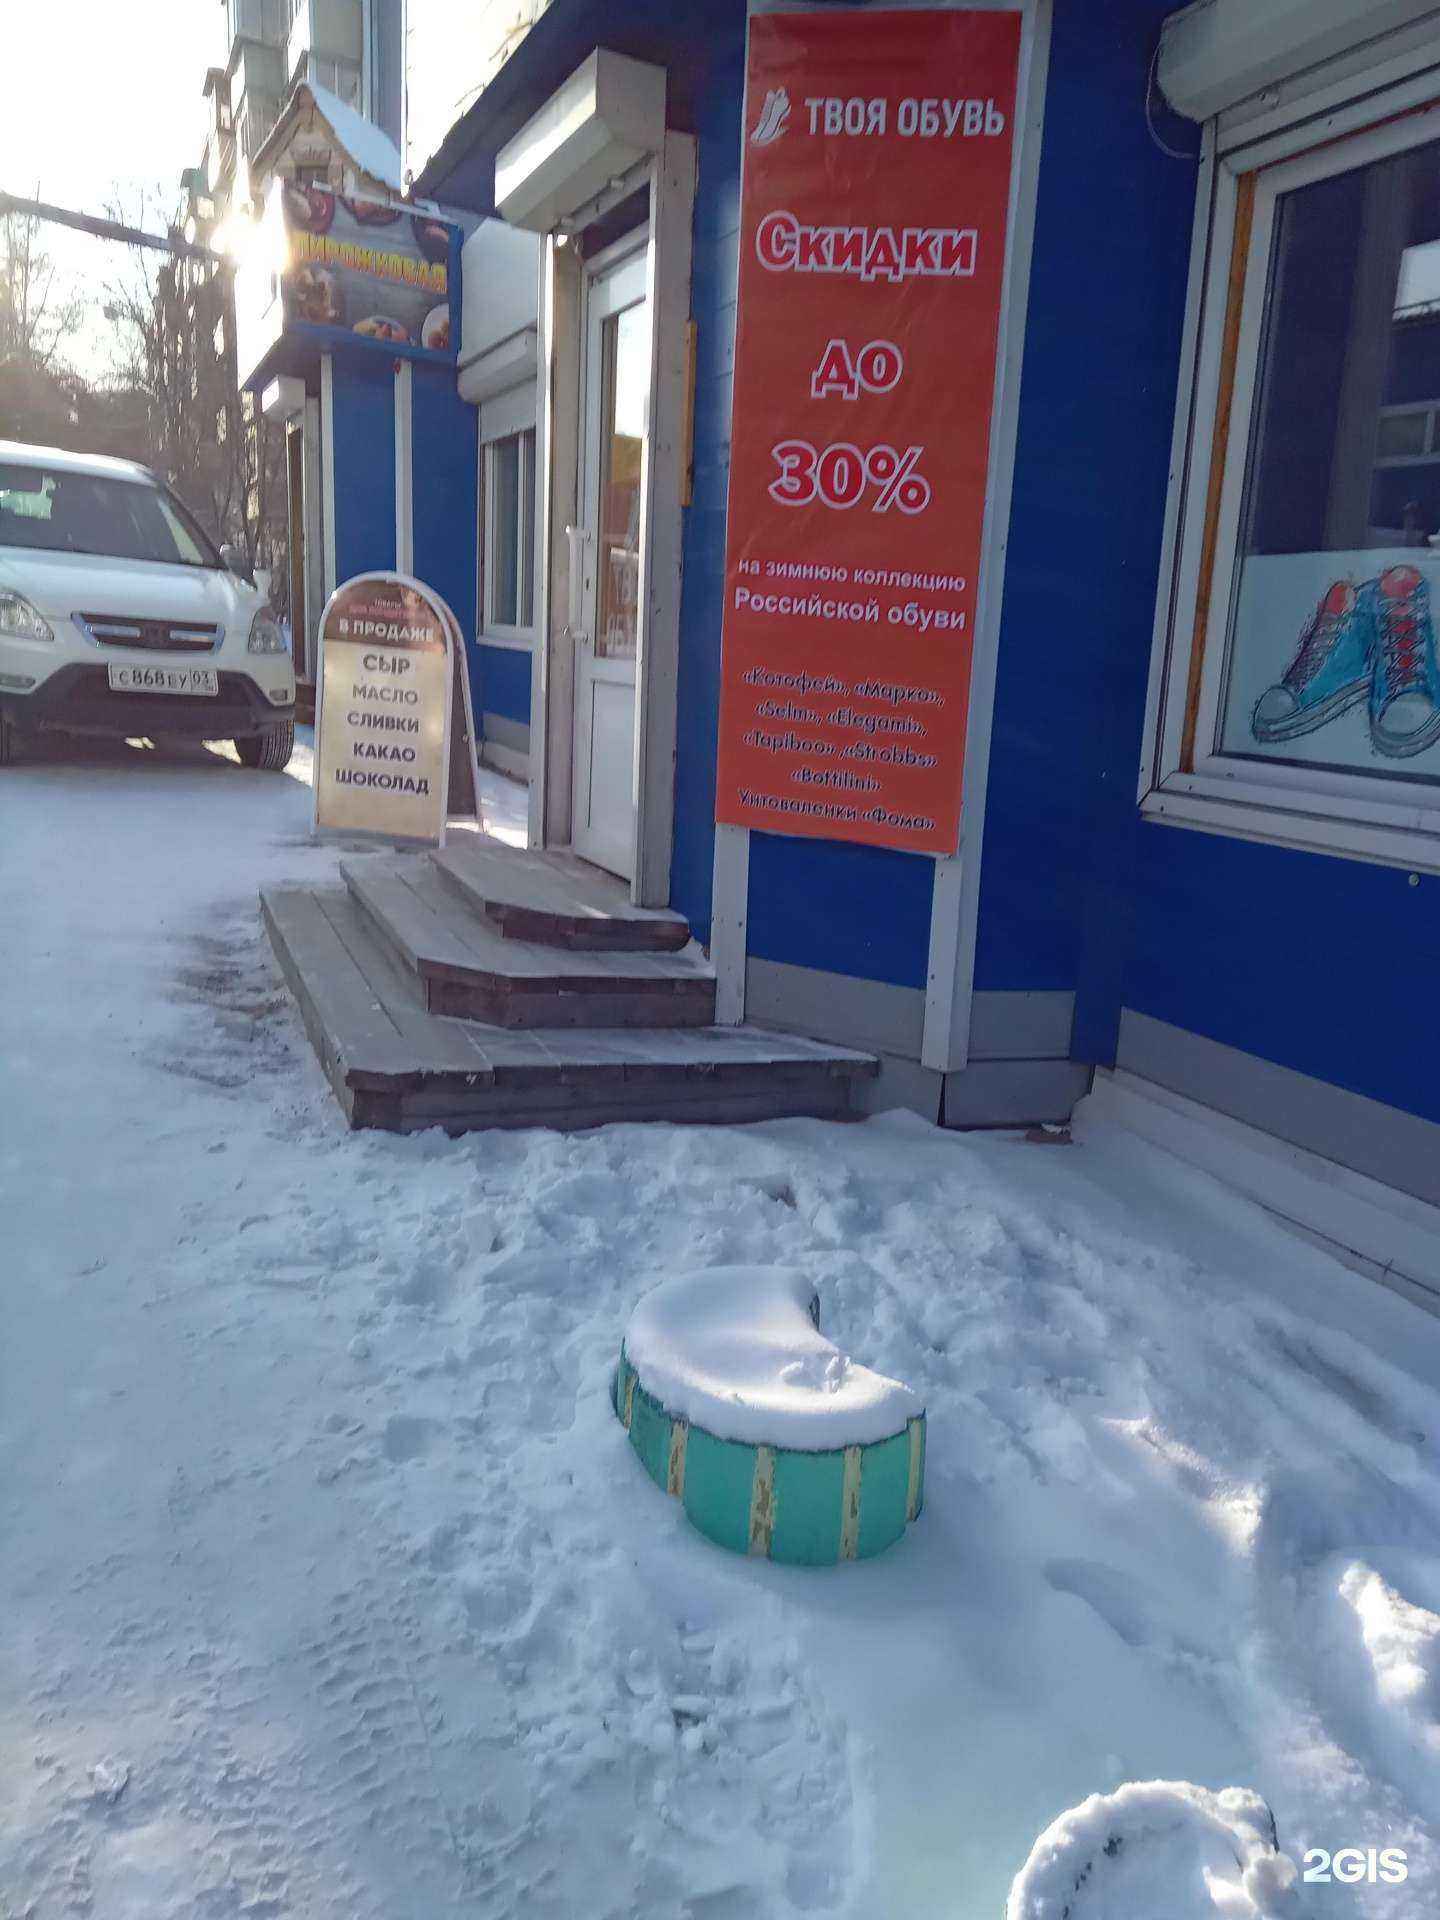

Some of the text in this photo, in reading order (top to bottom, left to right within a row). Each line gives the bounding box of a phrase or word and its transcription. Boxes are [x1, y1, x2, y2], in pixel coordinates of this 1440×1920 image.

[804, 98, 1006, 138] ТВОЯ ОБУВЬ
[755, 210, 979, 283] Скидки
[768, 439, 932, 515] 30%
[738, 559, 967, 593] на зимнюю коллекцию
[734, 586, 967, 632] Российской обуви
[339, 617, 435, 643] В ПРОДАЖЕ
[362, 653, 411, 675] СЫР
[352, 683, 419, 706] МАСЛО
[347, 711, 420, 734] СЛИВКИ
[353, 741, 416, 763] КАКАО
[335, 768, 430, 796] ШОКОЛАД
